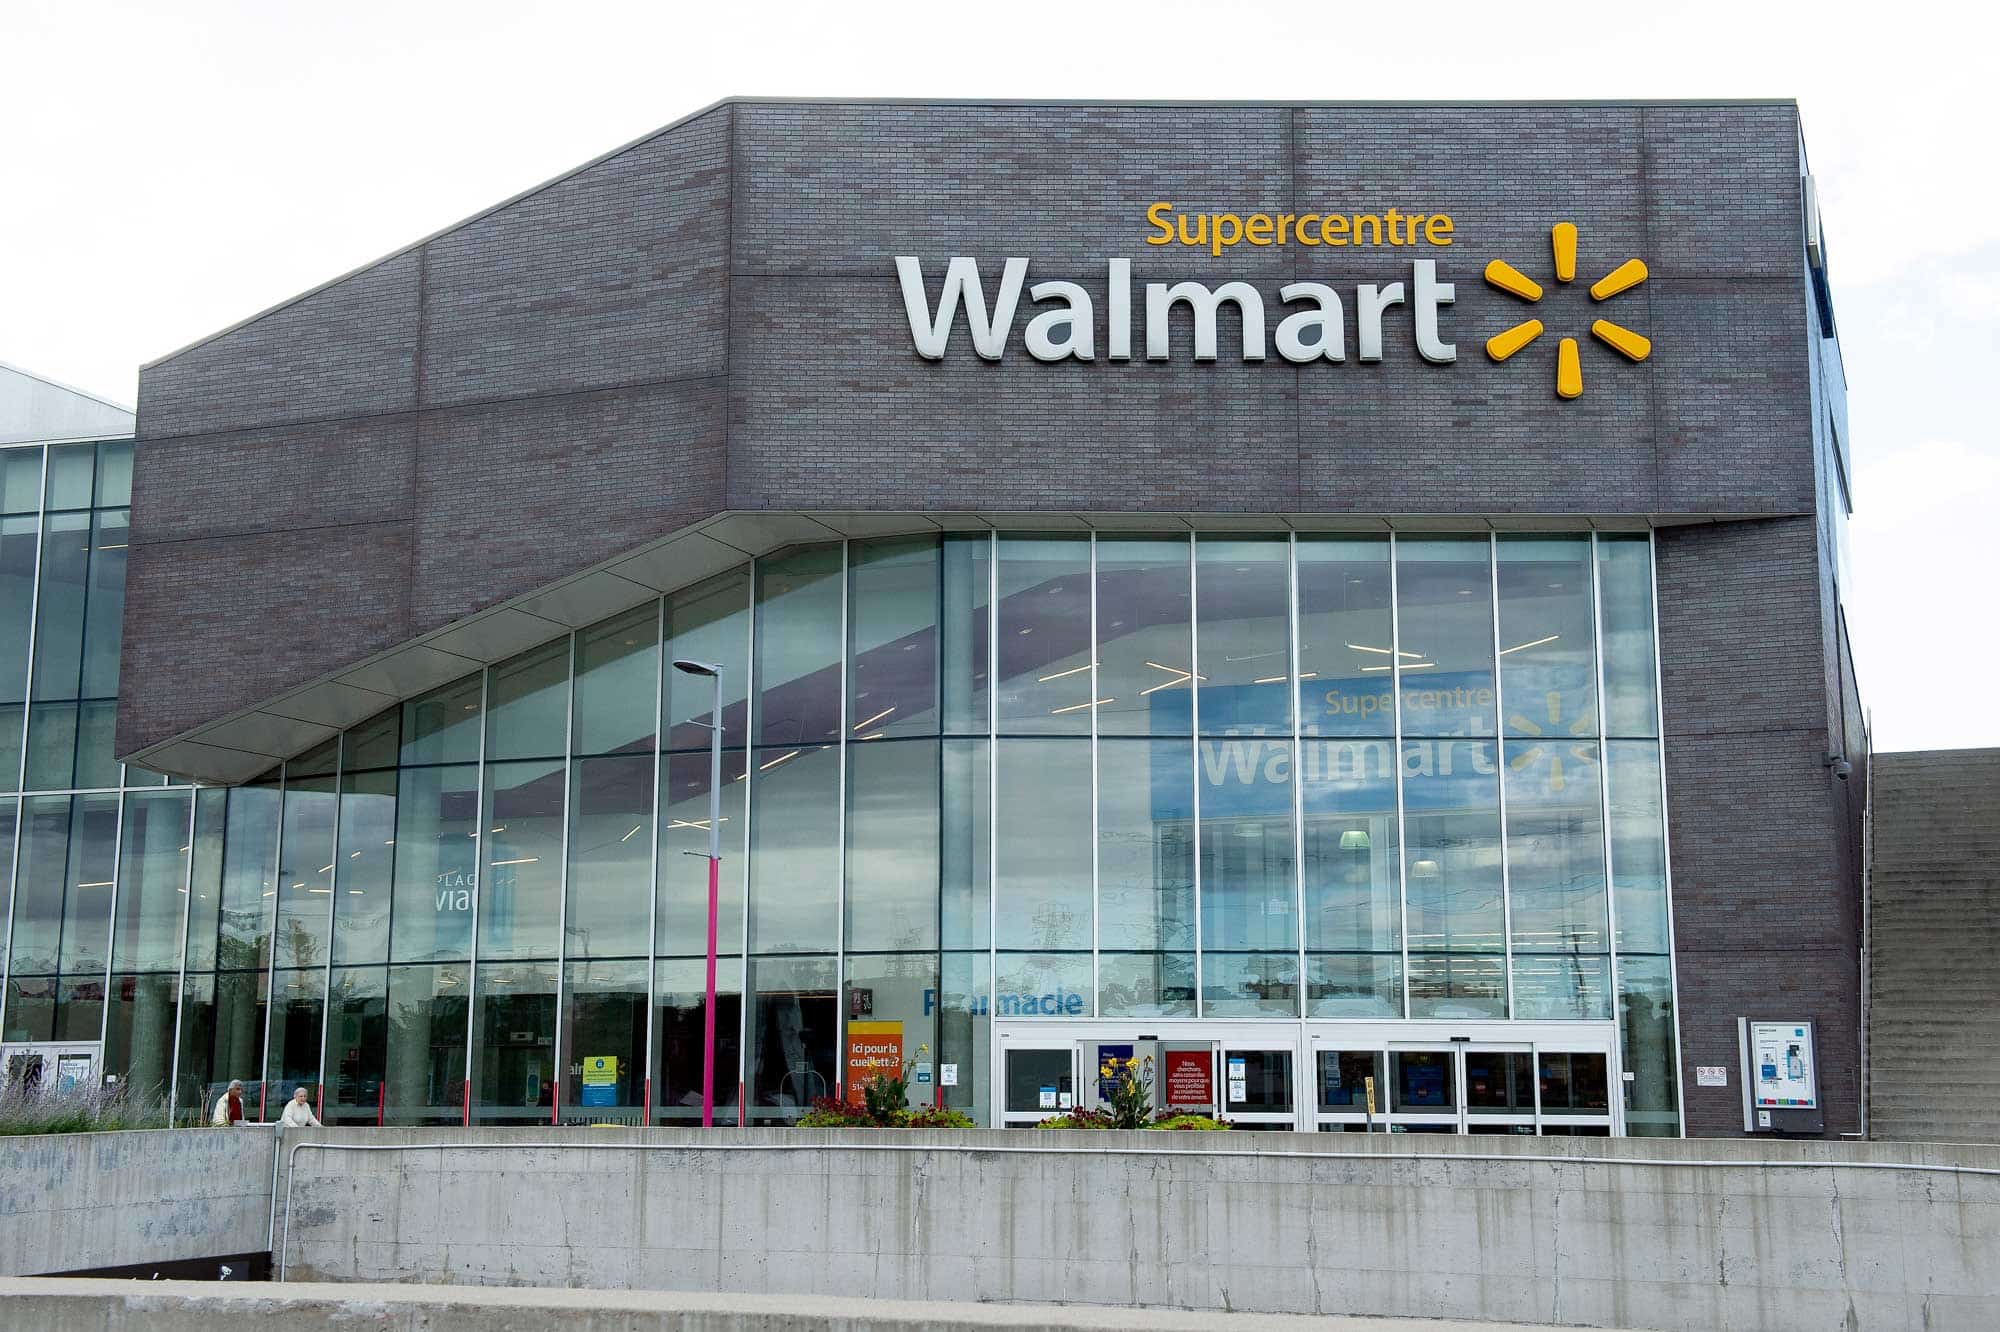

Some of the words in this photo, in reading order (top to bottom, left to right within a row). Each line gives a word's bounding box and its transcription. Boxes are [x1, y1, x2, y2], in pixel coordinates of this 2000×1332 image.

[1146, 202, 1454, 256] Supercentre
[895, 256, 1457, 362] Walmart
[1326, 686, 1492, 720] Supecentre
[1198, 716, 1497, 786] Walmart
[852, 1043, 863, 1054] Ici
[864, 1046, 887, 1056] pour
[889, 1043, 898, 1054] la
